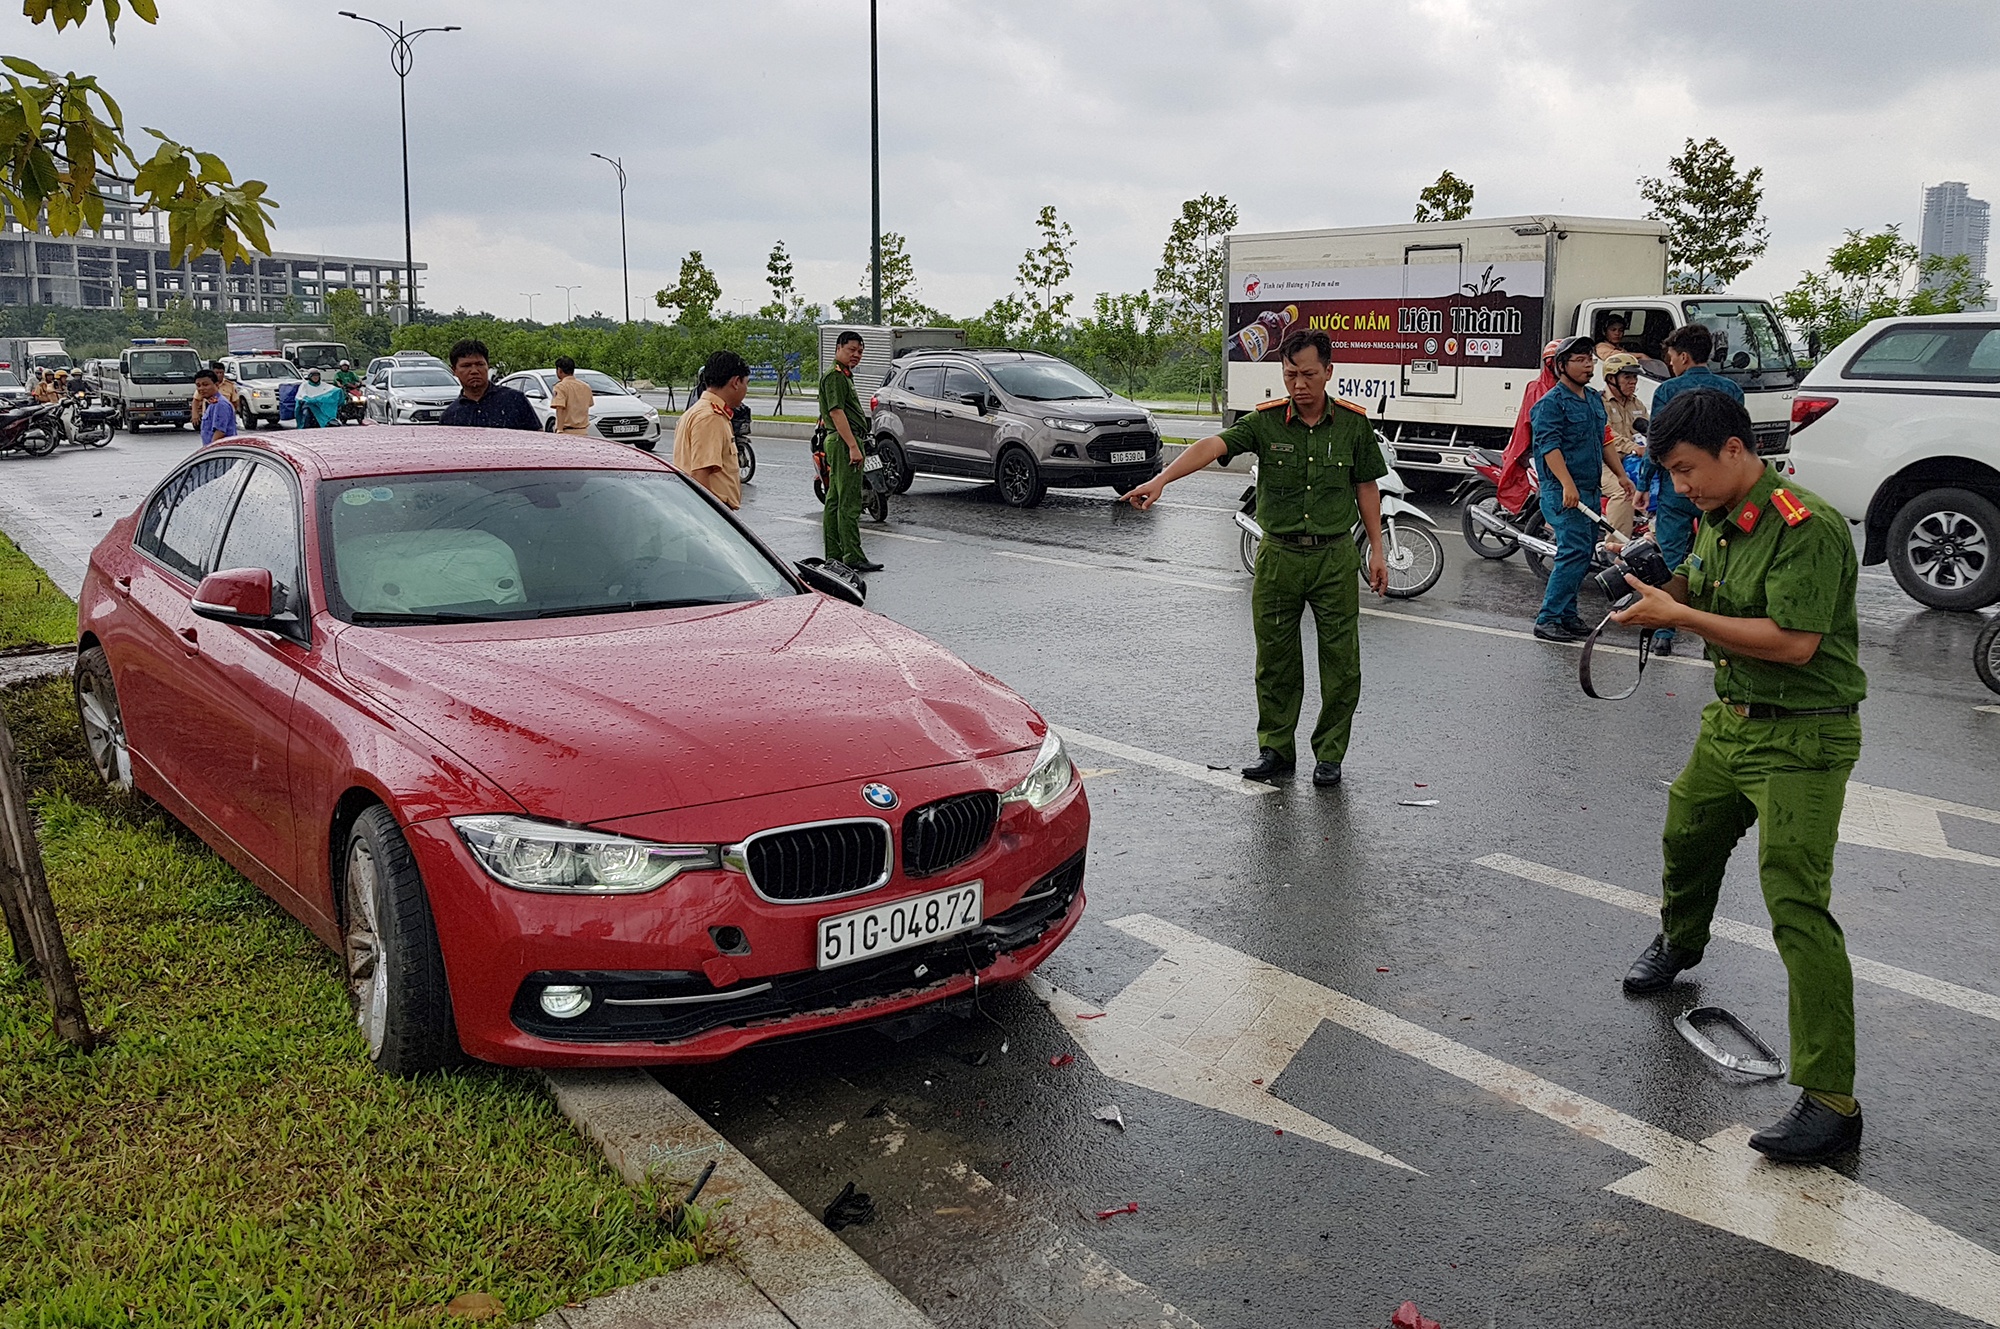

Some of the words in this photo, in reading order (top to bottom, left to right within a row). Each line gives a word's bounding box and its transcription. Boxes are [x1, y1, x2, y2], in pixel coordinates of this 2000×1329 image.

[1309, 312, 1350, 331] NƯỚC
[1353, 310, 1391, 331] MẮM
[1398, 306, 1443, 334] Liên
[1450, 306, 1522, 335] Thành
[1331, 341, 1350, 349] CODE:
[1350, 341, 1418, 350] NM469-NM563-NM564
[1338, 378, 1396, 399] 54Y-8711
[825, 888, 976, 961] 51G-048.72
